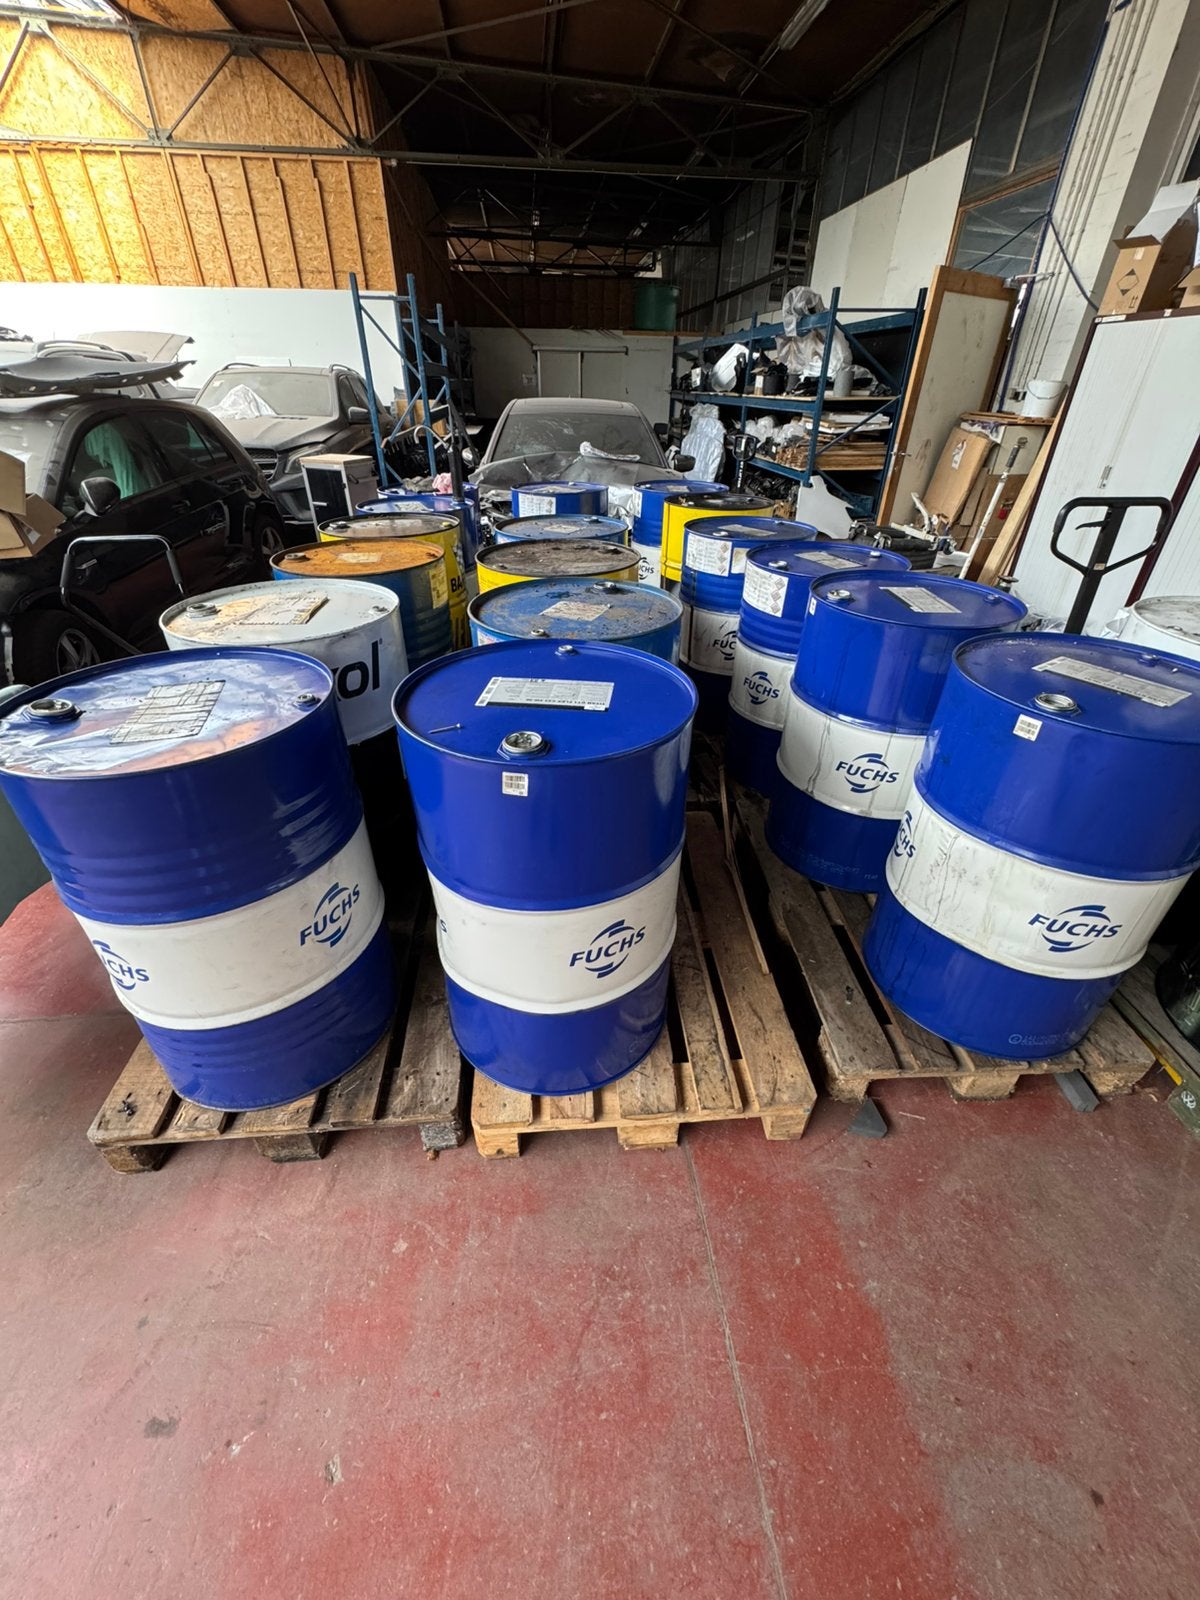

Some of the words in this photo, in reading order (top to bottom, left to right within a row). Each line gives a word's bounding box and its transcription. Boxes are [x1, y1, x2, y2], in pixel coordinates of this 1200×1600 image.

[640, 564, 655, 574] CHS
[712, 639, 737, 650] FUC
[743, 677, 780, 699] FUCHS
[834, 761, 900, 783] FUCHS
[899, 825, 916, 858] CHS
[300, 883, 361, 947] FUCHS
[1028, 913, 1123, 938] FUCHS
[569, 925, 647, 967] FUCHS
[102, 955, 150, 982] CHS
